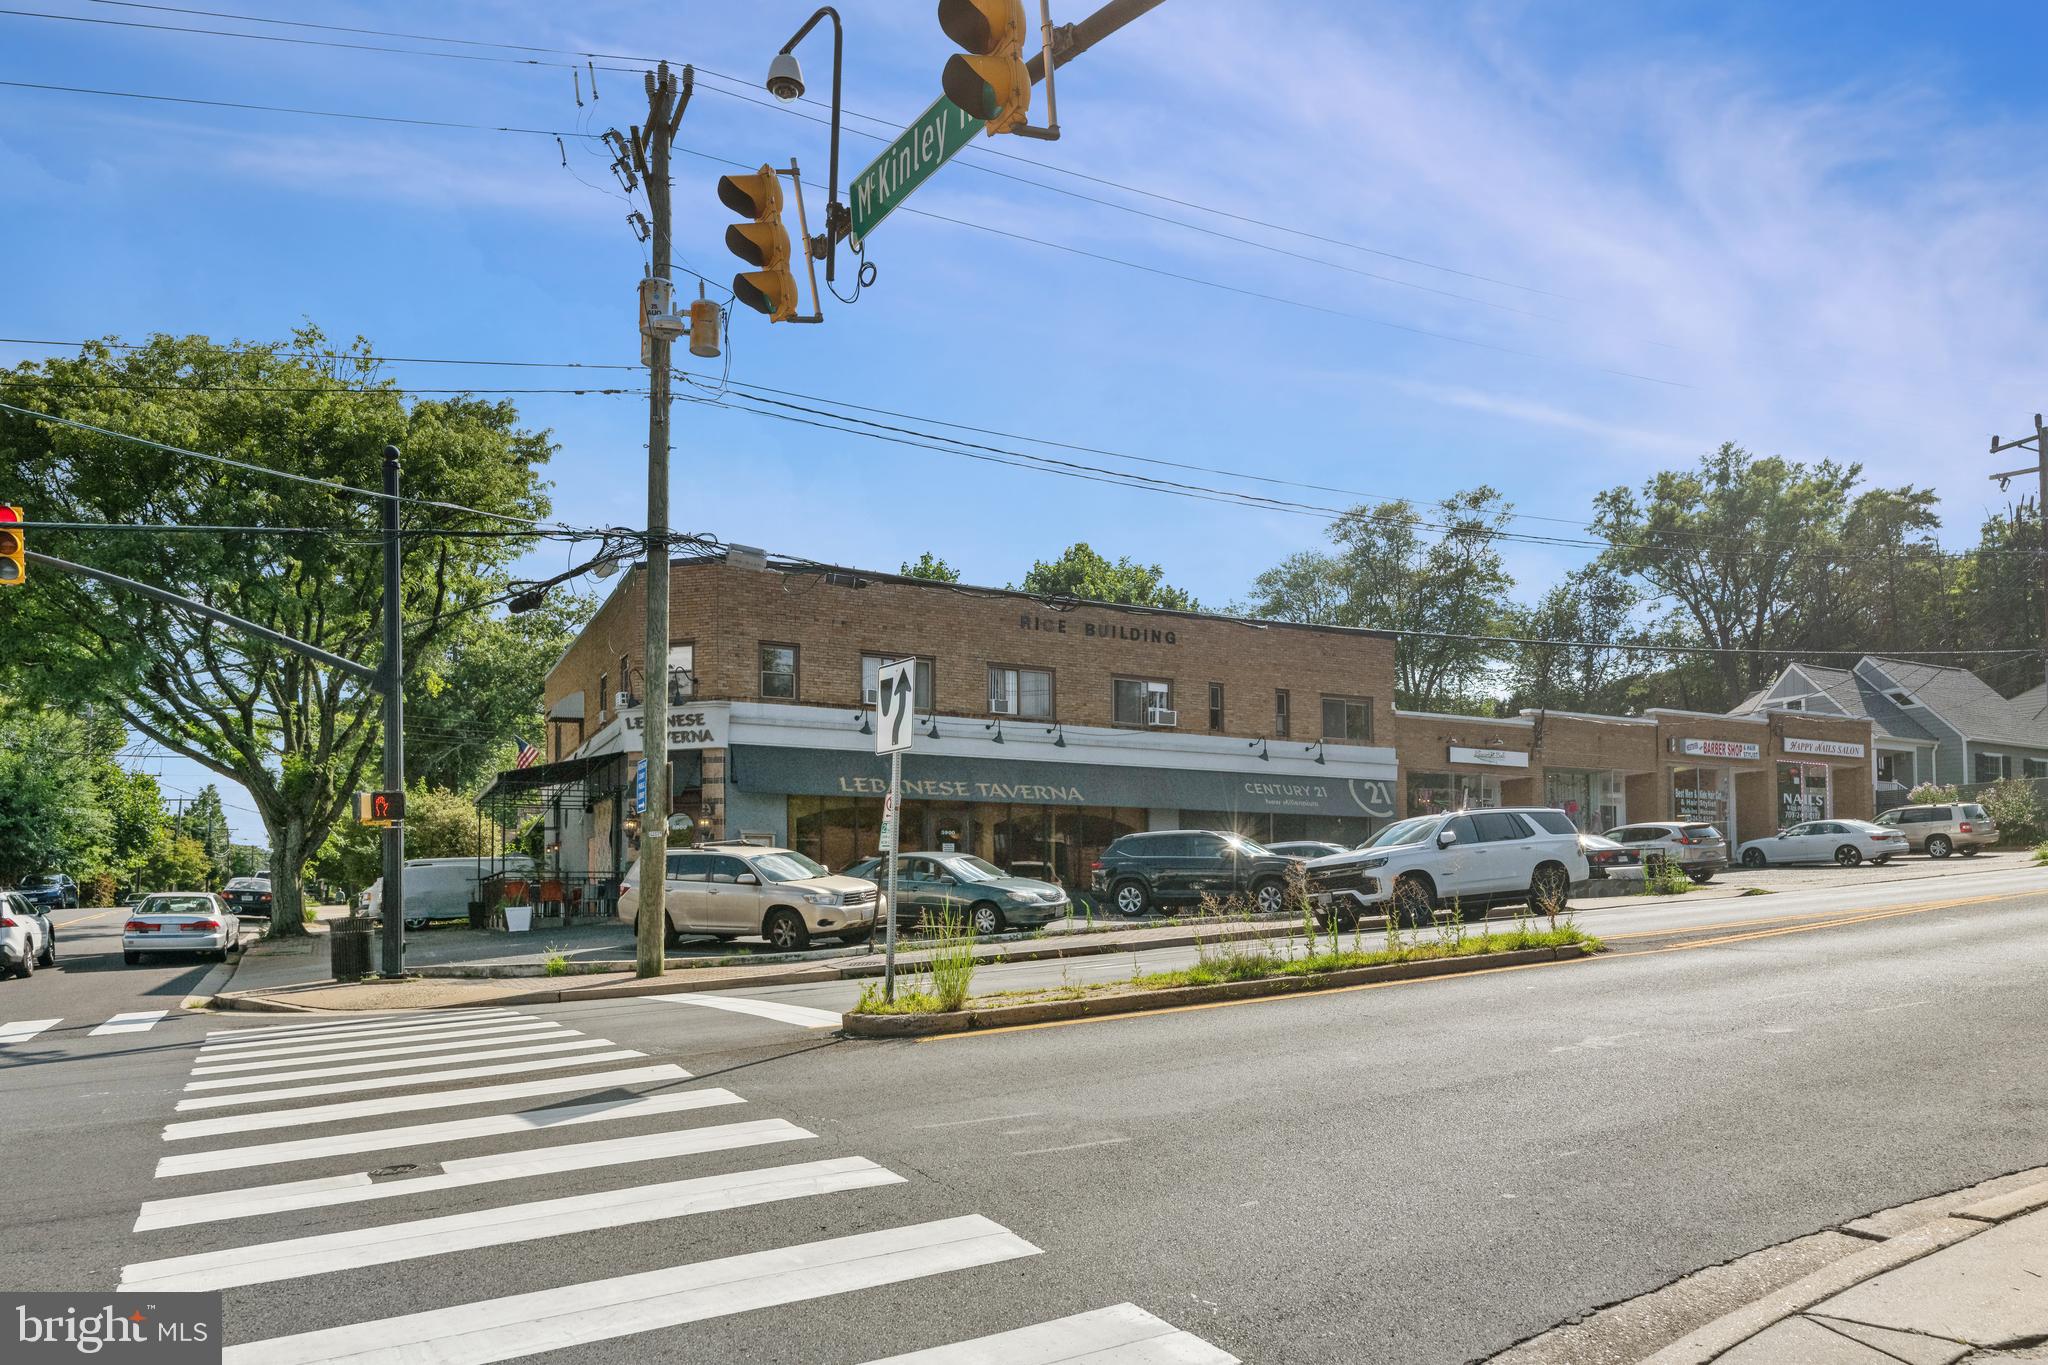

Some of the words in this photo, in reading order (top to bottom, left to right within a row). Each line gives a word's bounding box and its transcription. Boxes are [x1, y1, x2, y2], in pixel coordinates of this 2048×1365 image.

[1020, 615, 1067, 634] RICE
[1085, 623, 1176, 645] BUILDING
[625, 712, 706, 730] LENESE
[1703, 741, 1726, 756] BARBER
[1727, 743, 1742, 757] SHOP
[1790, 740, 1813, 752] HAPPY
[1815, 742, 1837, 753] NAILS
[1837, 744, 1860, 755] SALON
[975, 782, 1084, 801] TAVERNA
[1244, 782, 1311, 798] CENTURY
[1313, 786, 1328, 798] 21
[1783, 792, 1823, 806] NAILS
